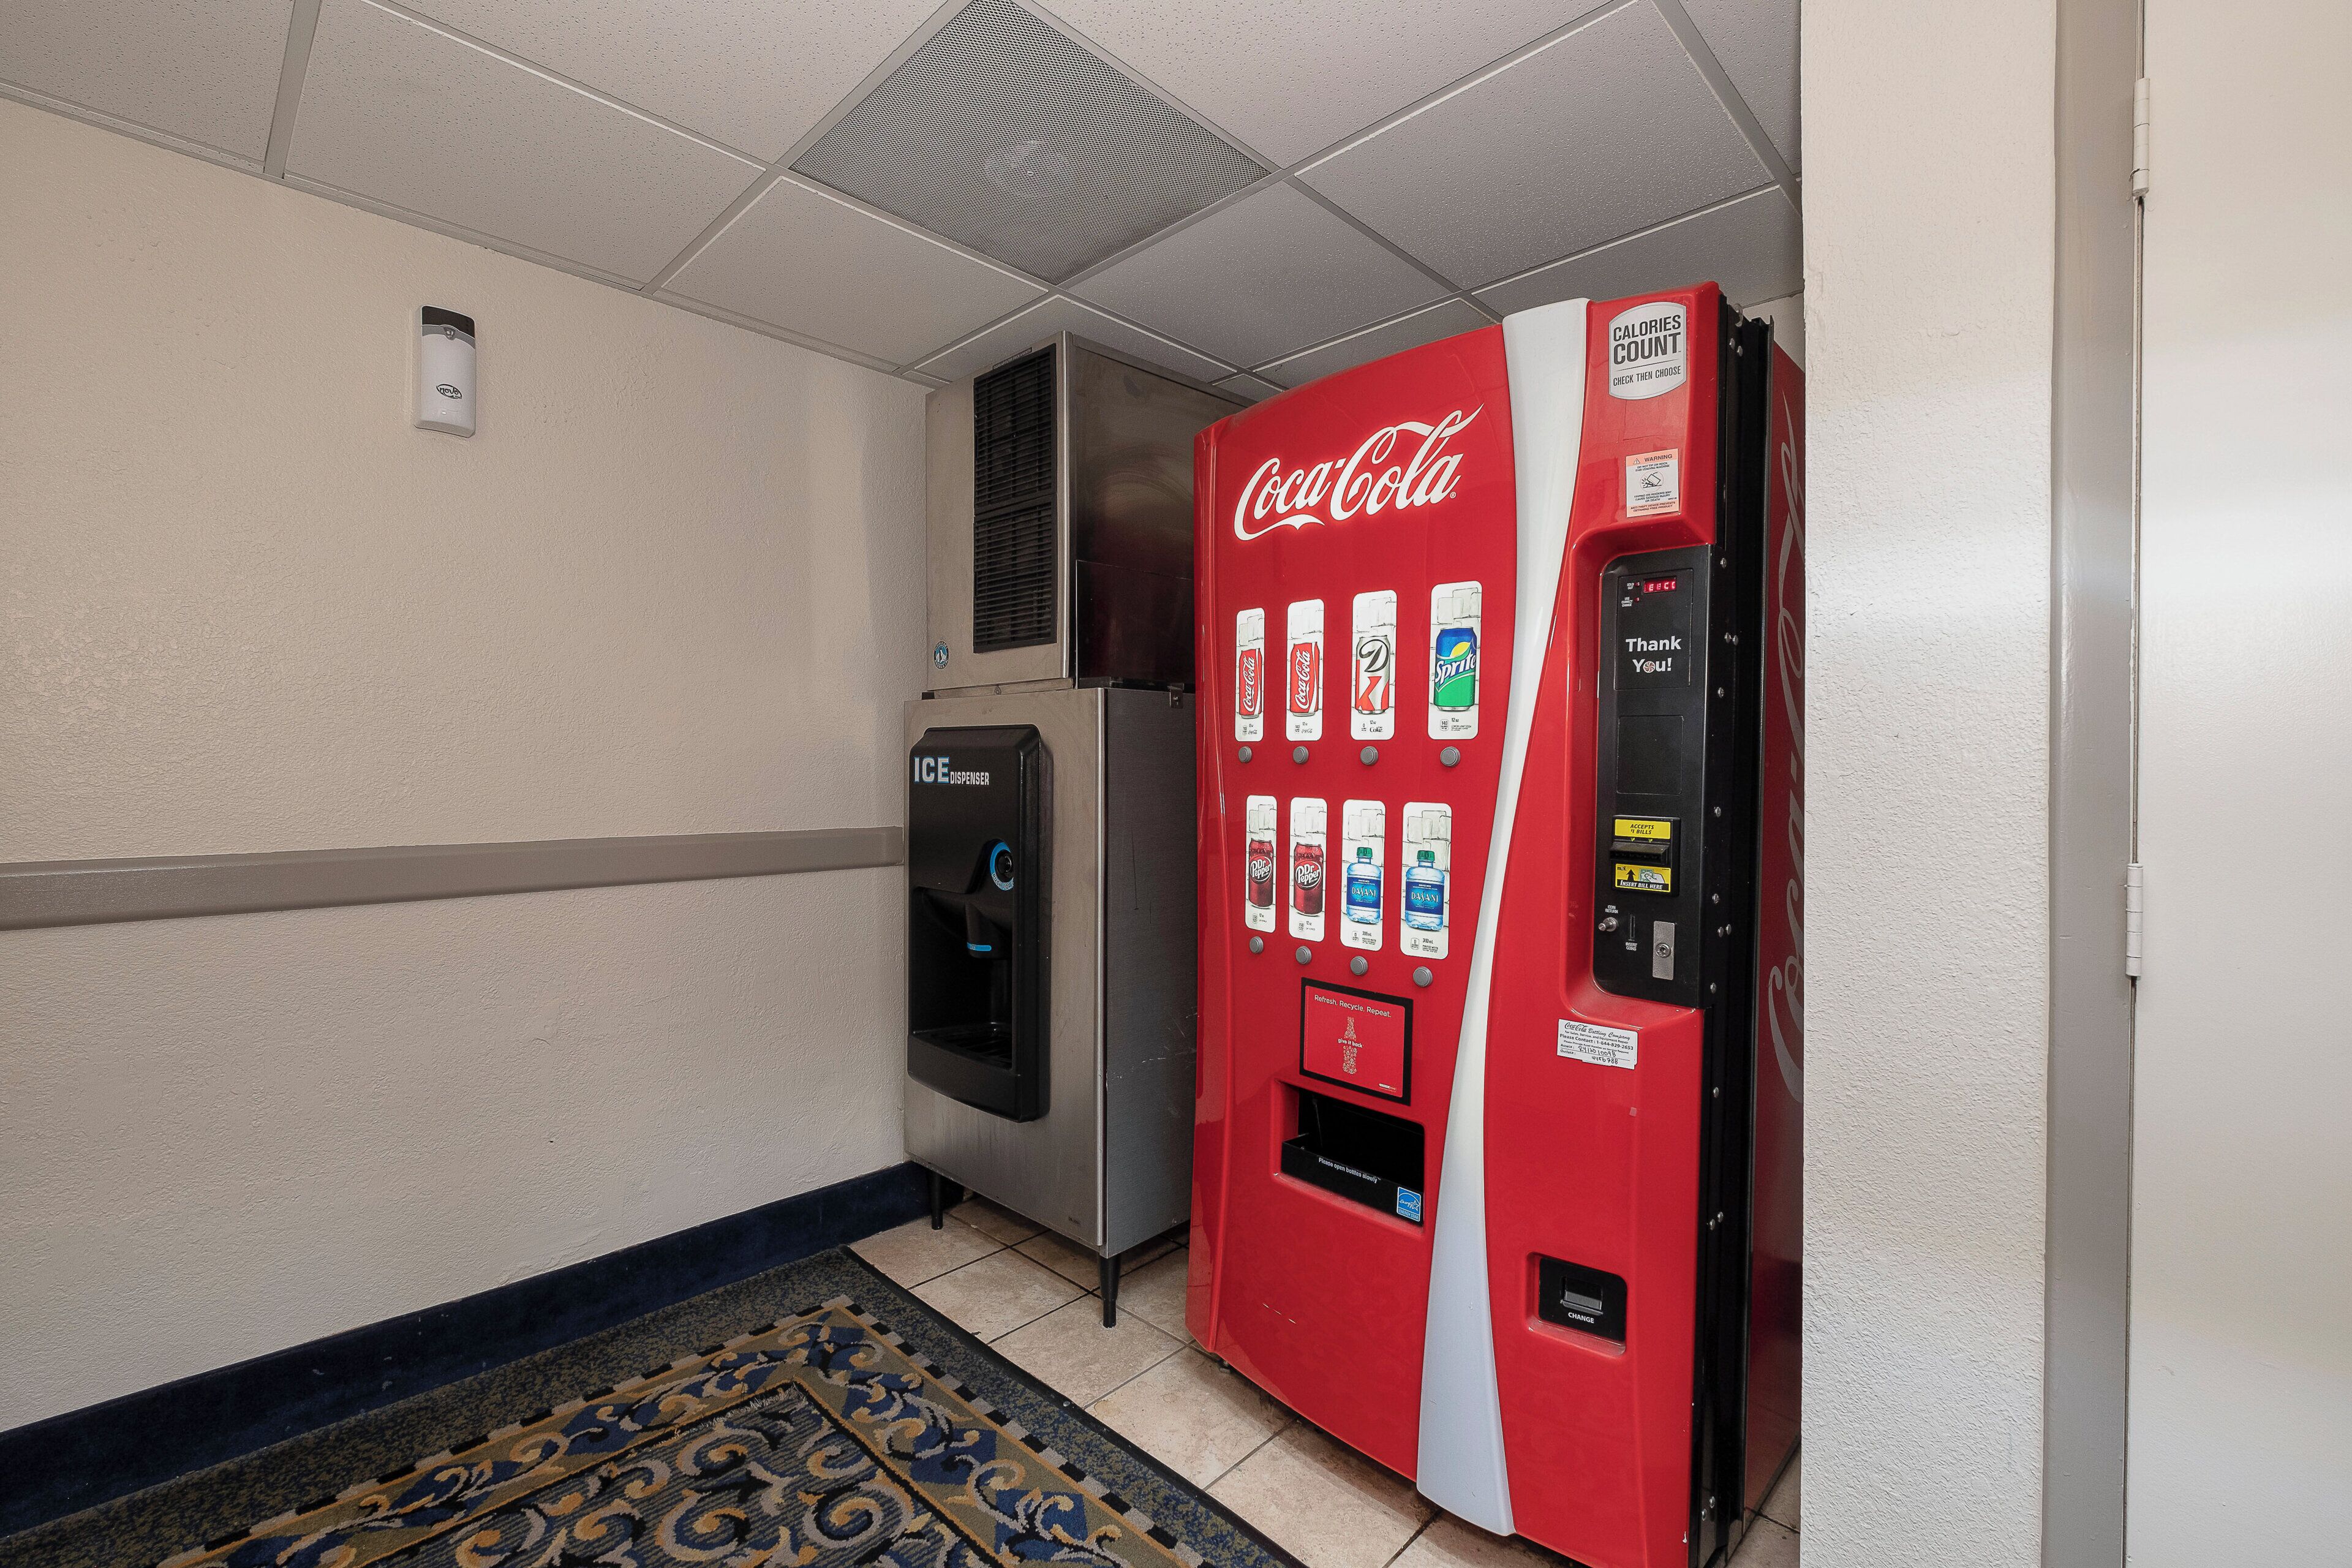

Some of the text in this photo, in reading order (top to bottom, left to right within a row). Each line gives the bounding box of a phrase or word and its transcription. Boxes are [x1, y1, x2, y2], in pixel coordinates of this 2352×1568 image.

[1613, 314, 1681, 342] CALORIES
[1613, 332, 1681, 364] COUNT
[1613, 365, 1681, 386] CHECK THEN CHOOSE
[1644, 454, 1673, 462] WARNING
[1234, 403, 1485, 541] Coca-Cola
[1626, 636, 1681, 652] Thank
[1435, 648, 1476, 686] Sprite
[914, 756, 989, 785] ICE DISPENSER
[1252, 861, 1272, 879] Pepper
[1257, 859, 1266, 869] Dr
[1305, 864, 1315, 873] Dr
[1297, 865, 1321, 884] Pepper
[1352, 886, 1376, 897] DASANI
[1411, 891, 1438, 902] DASANI
[1314, 994, 1392, 1018] Refresh. Recycle. Repeat.
[1596, 1040, 1634, 1050] 1-844-829-2653
[1608, 1032, 1630, 1041] Company
[1318, 1157, 1333, 1167] Please
[1346, 1167, 1362, 1177] bottles
[1362, 1174, 1378, 1184] slowly
[1568, 1312, 1594, 1324] CHANGE
